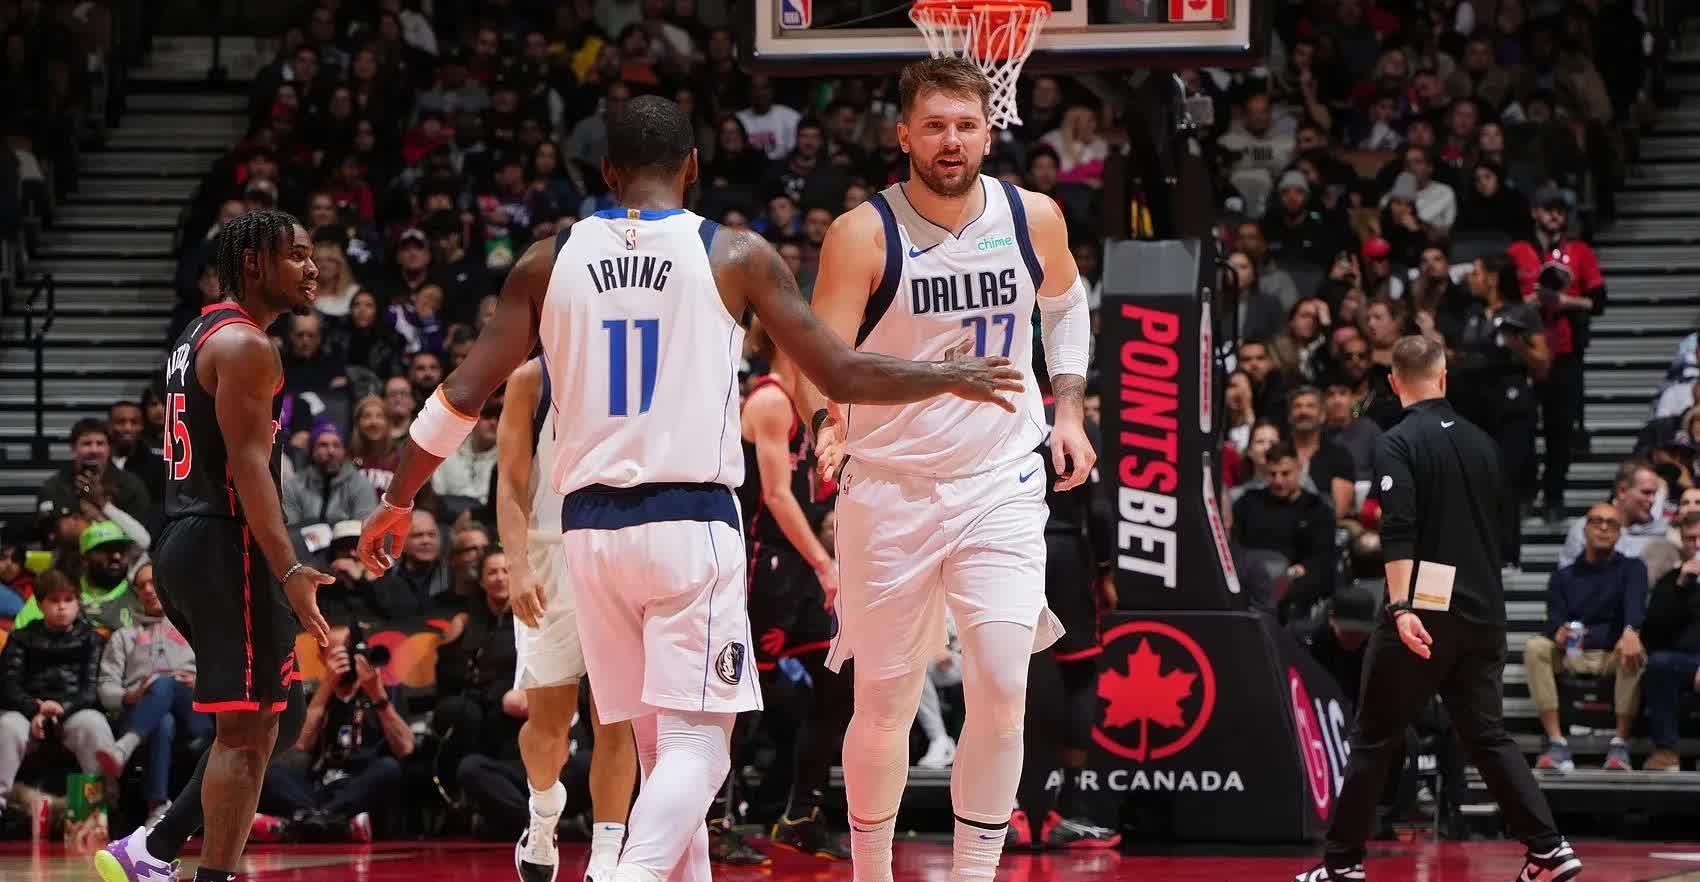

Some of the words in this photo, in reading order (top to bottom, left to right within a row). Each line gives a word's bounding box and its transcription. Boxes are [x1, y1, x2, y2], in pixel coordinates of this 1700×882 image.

[977, 236, 1013, 252] chime
[586, 255, 673, 295] IRVING
[911, 268, 1017, 315] DALLAS
[602, 318, 660, 418] 11
[1118, 303, 1180, 589] POINTSBET
[1044, 769, 1100, 792] AR
[1107, 769, 1245, 792] CANADA
